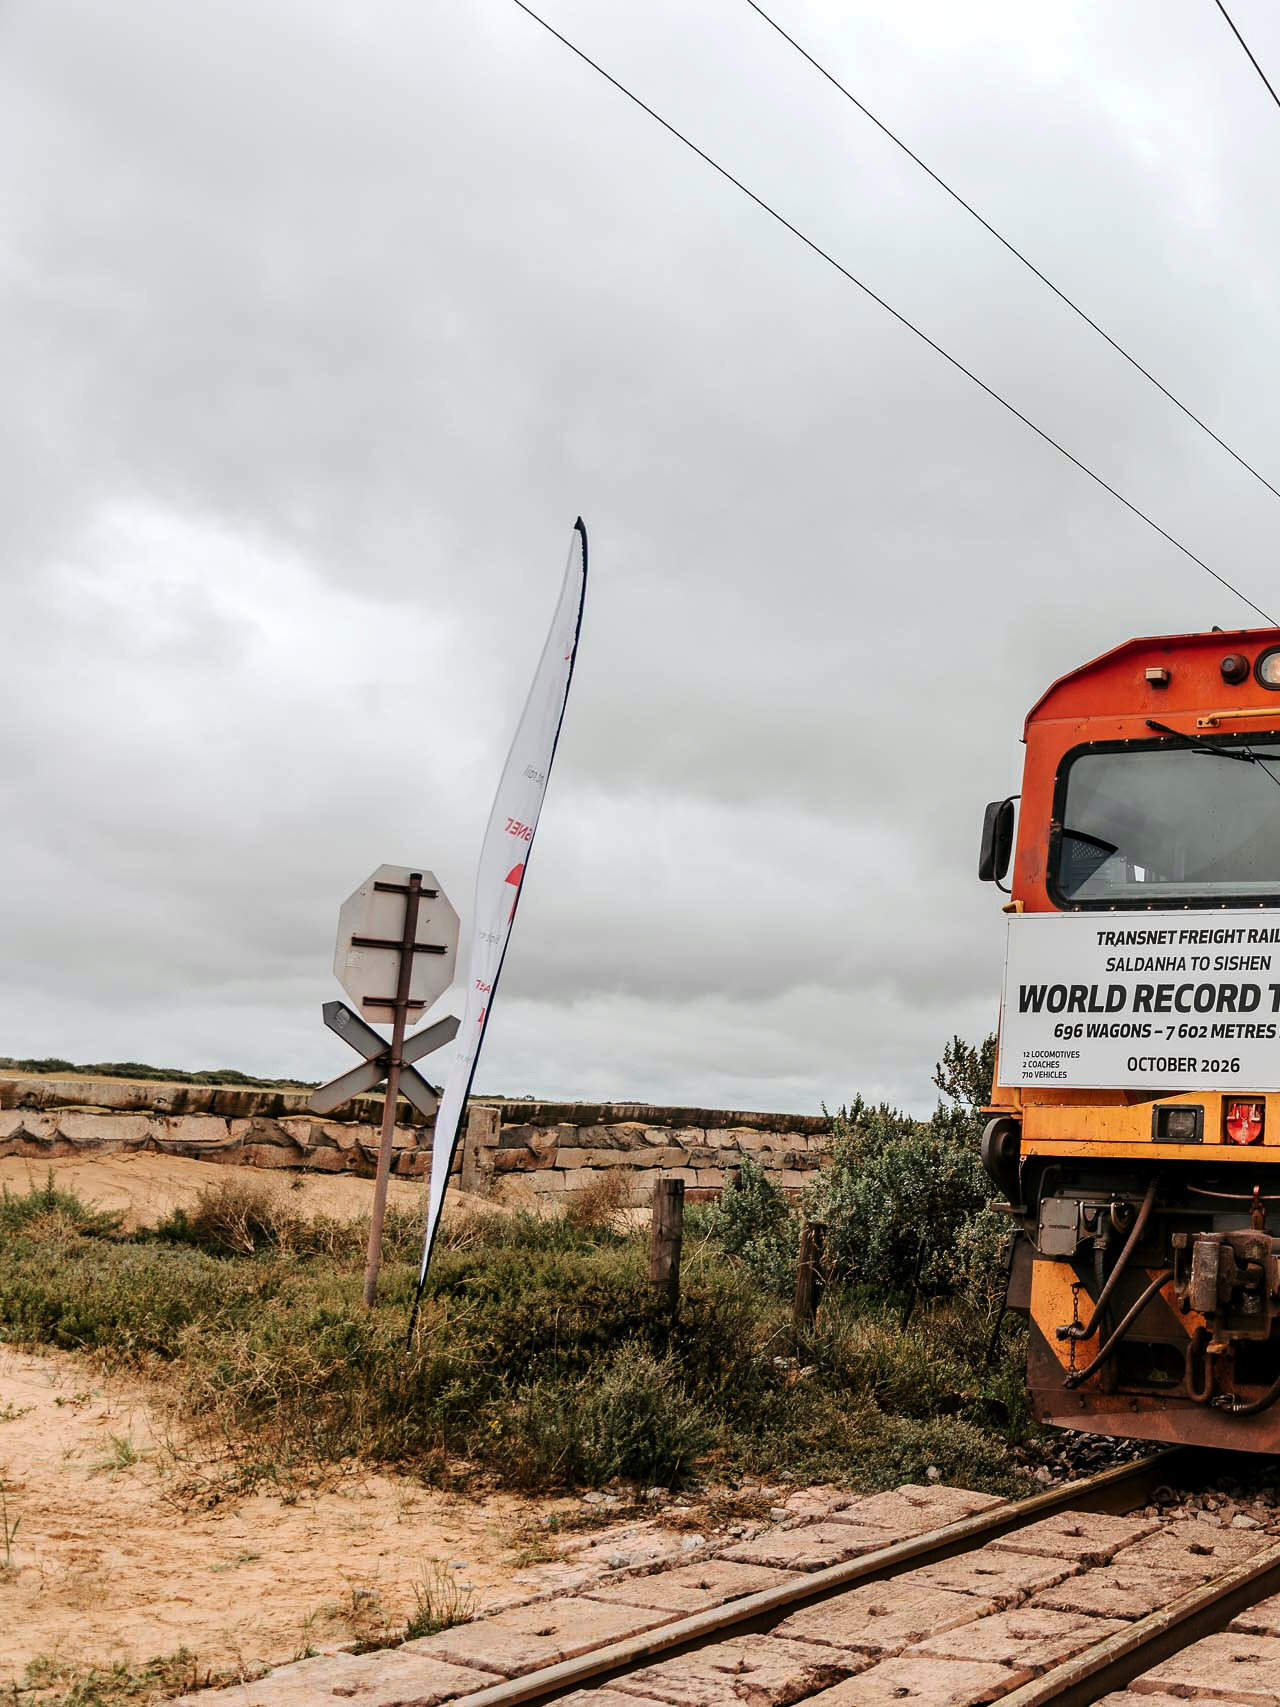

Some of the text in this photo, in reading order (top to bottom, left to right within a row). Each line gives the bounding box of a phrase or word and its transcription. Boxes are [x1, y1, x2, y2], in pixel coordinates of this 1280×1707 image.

[1096, 929, 1178, 946] TRANSNET
[1178, 928, 1247, 945] FREIGHT
[1105, 955, 1272, 973] SALDANHA TO SISHEN
[1018, 983, 1128, 1014] WORLD
[1131, 982, 1262, 1014] RECORD
[1053, 1022, 1084, 1041] 696
[1086, 1023, 1153, 1039] WAGONS
[1165, 1025, 1176, 1041] 7
[1177, 1023, 1208, 1039] 602
[1210, 1023, 1277, 1040] METRES
[1031, 1050, 1081, 1059] LOCOMOTIVES
[1022, 1060, 1060, 1069] 2 COACHES
[1126, 1056, 1241, 1073] OCTOBER 2026
[1034, 1070, 1068, 1079] VEHICLES
